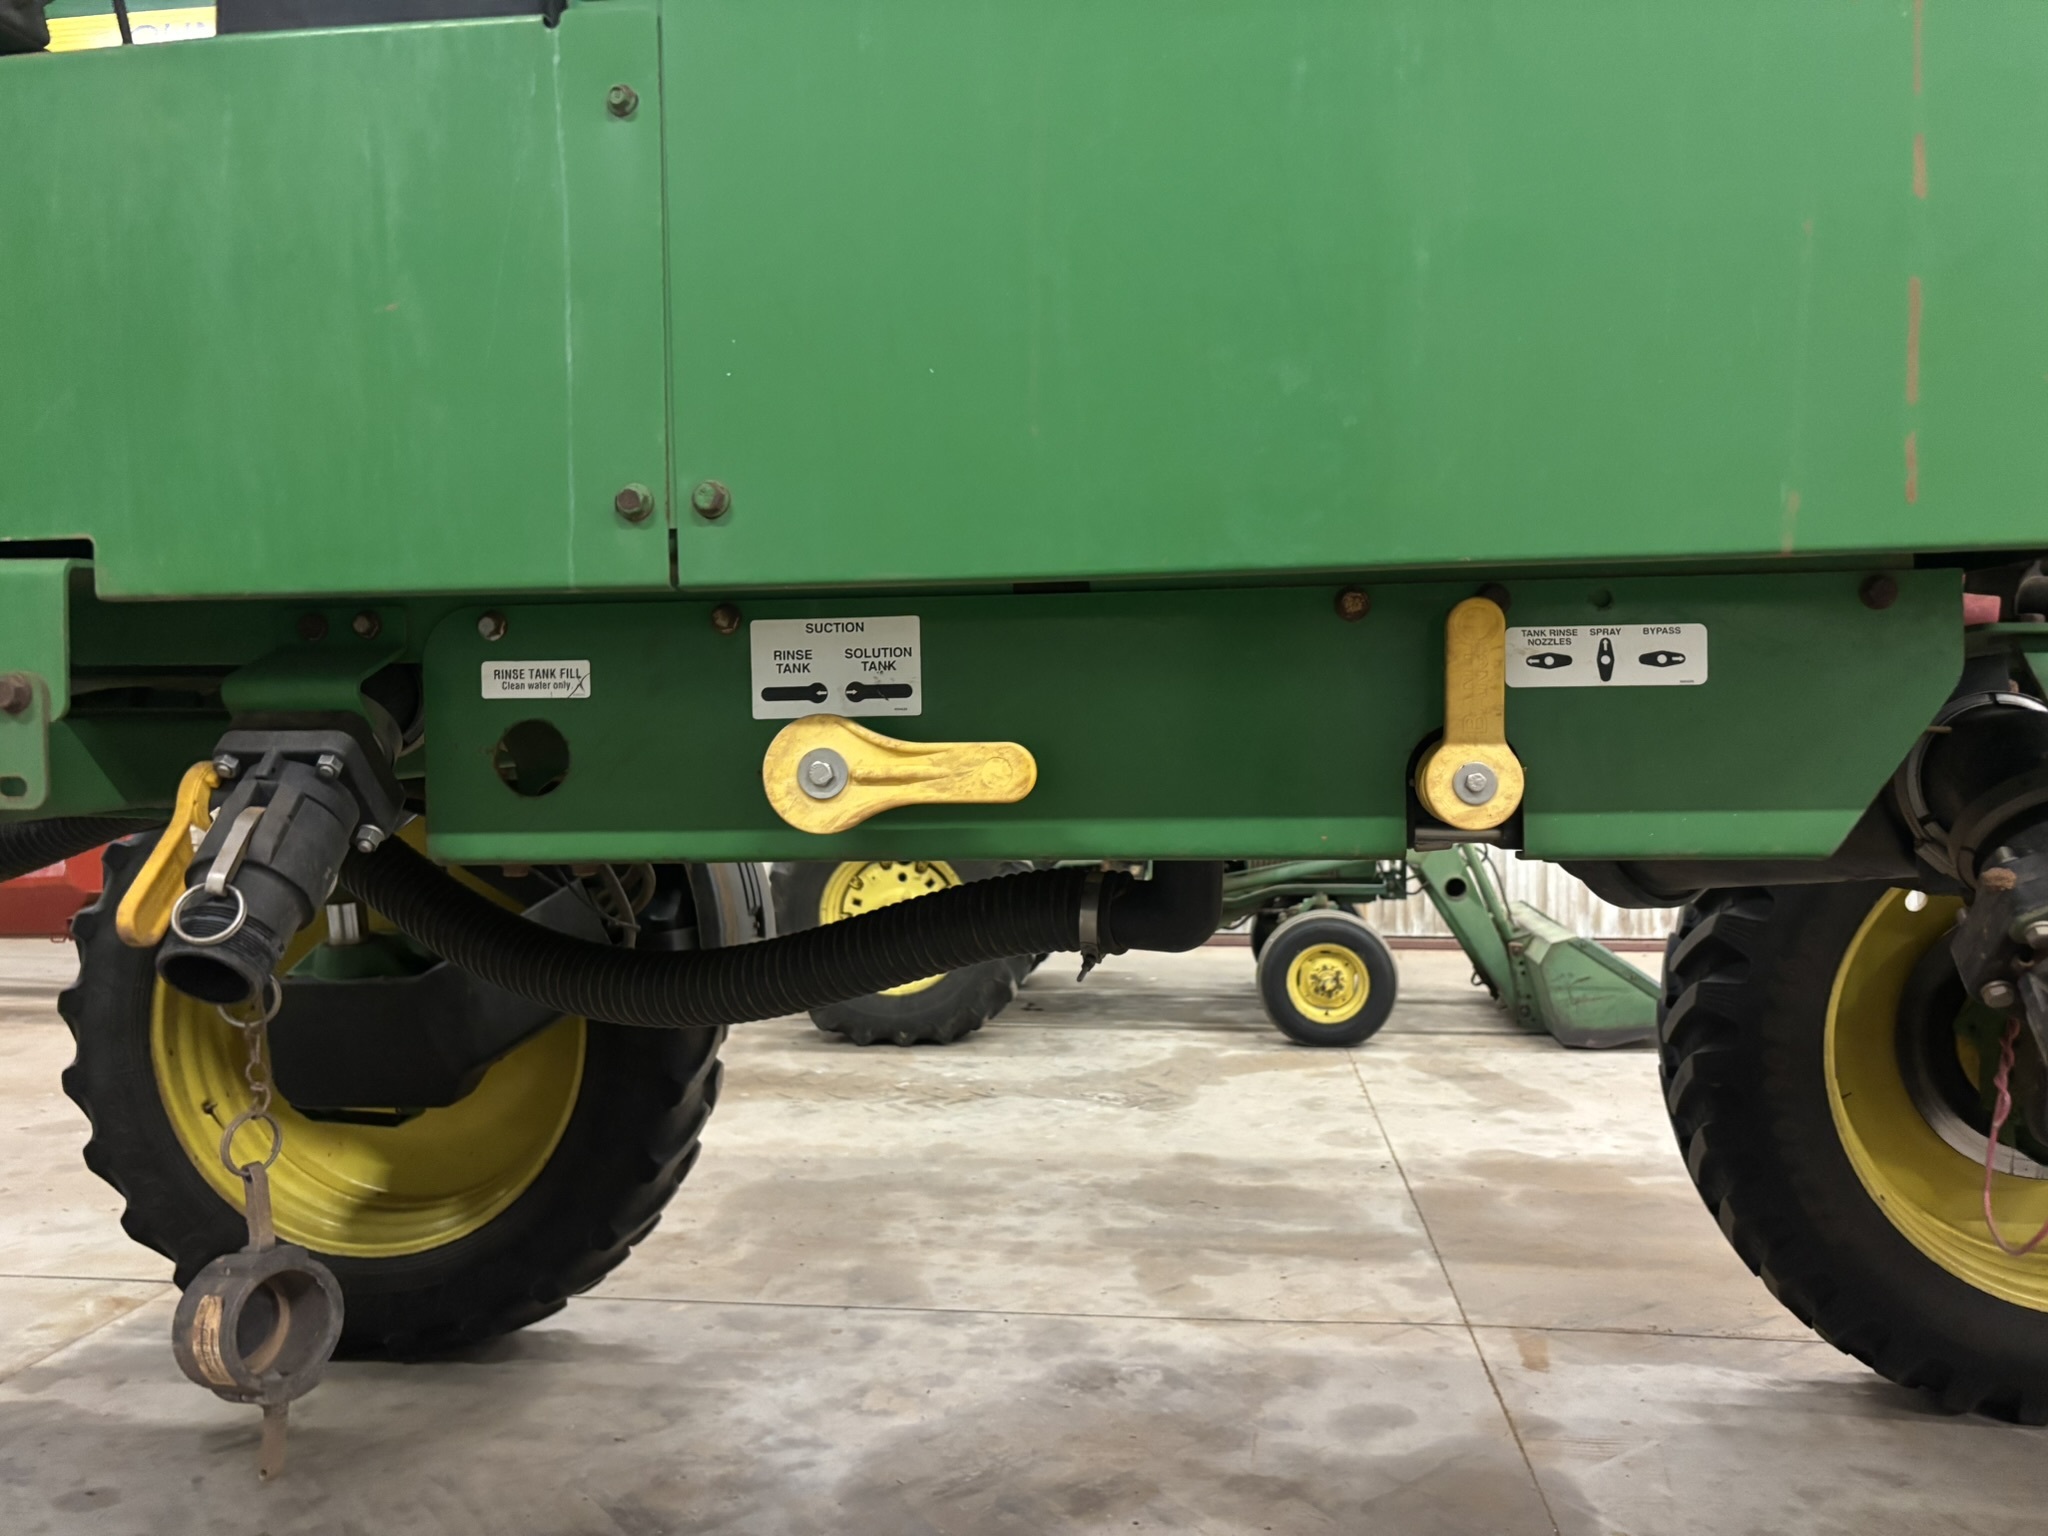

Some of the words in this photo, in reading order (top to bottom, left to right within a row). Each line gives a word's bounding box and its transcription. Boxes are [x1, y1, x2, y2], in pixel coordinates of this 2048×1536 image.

[805, 622, 865, 634] SUCTION
[1521, 629, 1546, 637] TANK
[1549, 628, 1578, 637] RINSE
[1590, 628, 1622, 636] SPRAY
[1643, 627, 1682, 635] BYPASS
[1527, 638, 1572, 646] NOZZLES
[774, 649, 813, 661] RINSE
[844, 647, 912, 659] SOLUTION
[776, 663, 811, 674] TANK
[861, 661, 897, 672] TANK
[494, 669, 525, 680] RINSE
[528, 668, 557, 679] TANK
[560, 668, 582, 679] FILL
[502, 681, 525, 690] Clean
[528, 681, 551, 690] water
[553, 681, 571, 692] only
